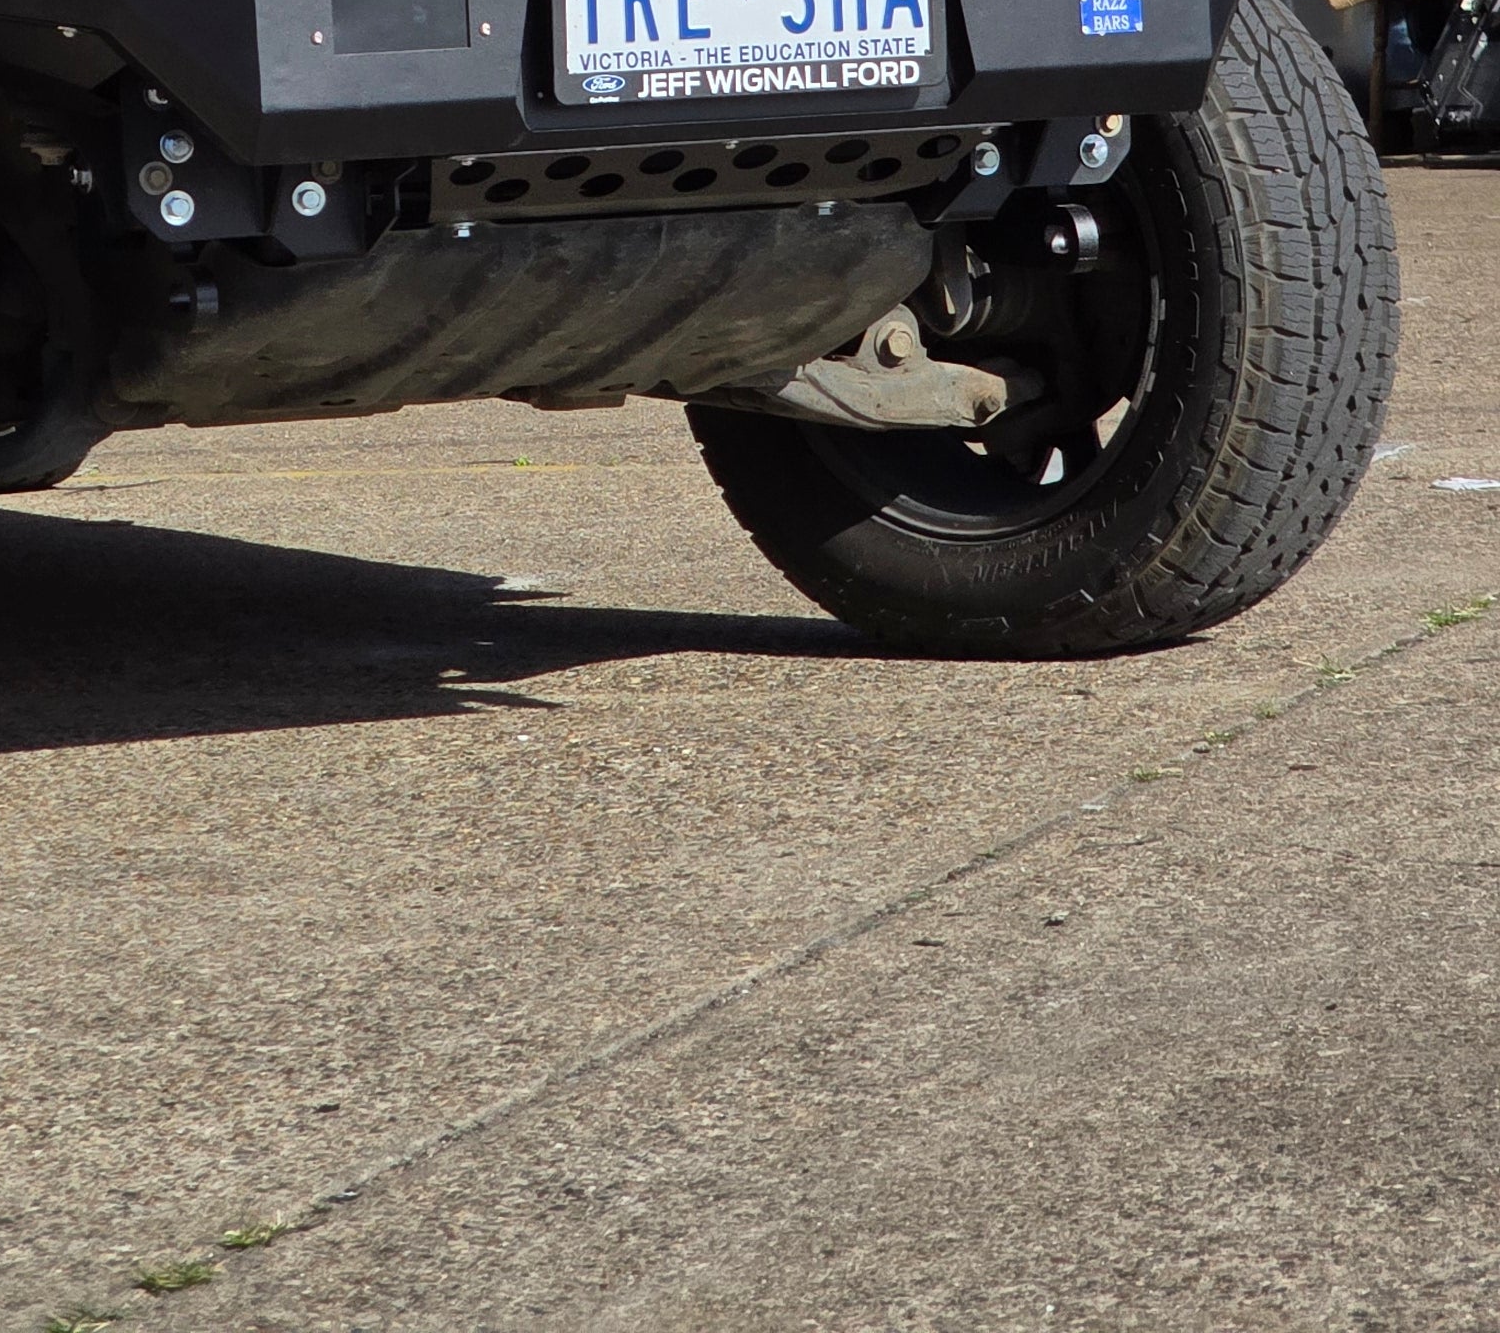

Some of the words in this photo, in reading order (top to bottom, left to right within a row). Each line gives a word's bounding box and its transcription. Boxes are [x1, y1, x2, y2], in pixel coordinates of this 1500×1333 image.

[1093, 15, 1130, 31] BARS
[579, 50, 673, 71] VICTORIA
[694, 47, 731, 65] THE
[739, 39, 851, 63] EDUCATION
[857, 37, 916, 57] STATE
[638, 71, 701, 98] JEFF
[705, 64, 837, 95] WIGNALL
[841, 60, 920, 87] FORD
